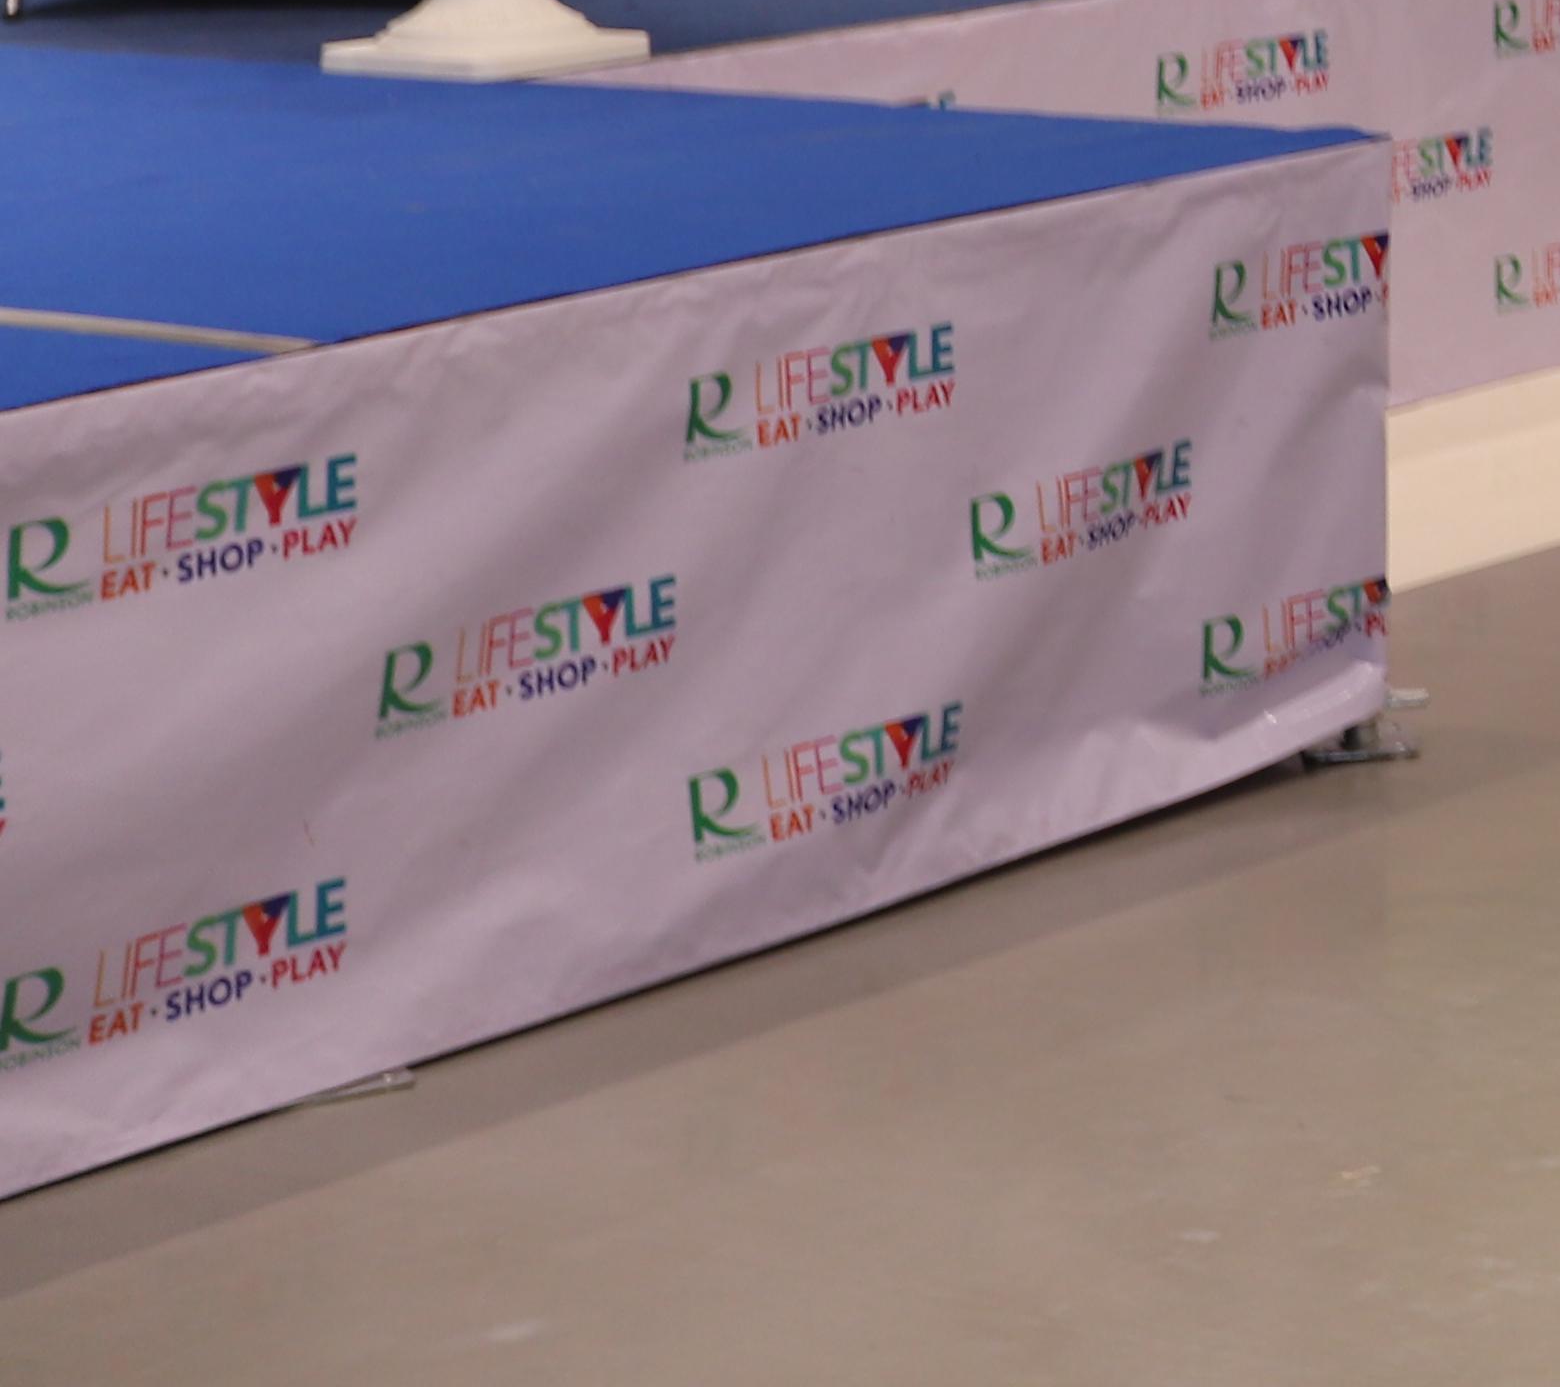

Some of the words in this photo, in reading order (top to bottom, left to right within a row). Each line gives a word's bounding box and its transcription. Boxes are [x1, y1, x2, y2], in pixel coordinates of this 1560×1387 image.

[1201, 28, 1328, 89] LIFESTYLE
[1391, 126, 1493, 182] FESTYLE
[1210, 259, 1252, 326] R
[1261, 229, 1389, 300] LIFESTY
[1261, 297, 1297, 331] EAT
[1311, 285, 1373, 322] SHOP
[685, 368, 746, 444] R
[754, 321, 955, 415] LIFESTYLE
[756, 413, 801, 449] EAT
[816, 394, 882, 436] SHOP
[895, 378, 955, 417] PLAY
[6, 515, 90, 602] R
[103, 452, 357, 564] LIFESTYLE
[970, 491, 1033, 562] R
[1035, 438, 1192, 534] LIFESTYLE
[1040, 530, 1078, 567] EAT
[1086, 508, 1137, 552] SHOP
[1141, 490, 1192, 530] PLAY
[100, 559, 156, 602] EAT
[176, 537, 265, 584] SHOP
[281, 517, 357, 560] PLAY
[377, 640, 444, 720] R
[456, 573, 676, 684] LIFESTYLE
[451, 678, 500, 719] EAT
[518, 654, 597, 700] SHOP
[610, 633, 675, 678] PLAY
[1201, 613, 1256, 682] R
[688, 767, 759, 844] R
[761, 700, 963, 809] LIFESTYLE
[769, 803, 815, 843] EAT
[830, 779, 897, 825] SHOP
[906, 758, 956, 799] PLAY
[0, 966, 80, 1052] R
[93, 876, 346, 1009] LIFESTYLE
[88, 1001, 144, 1047] EAT
[165, 968, 252, 1023] SHOP
[271, 939, 347, 991] PLAY
